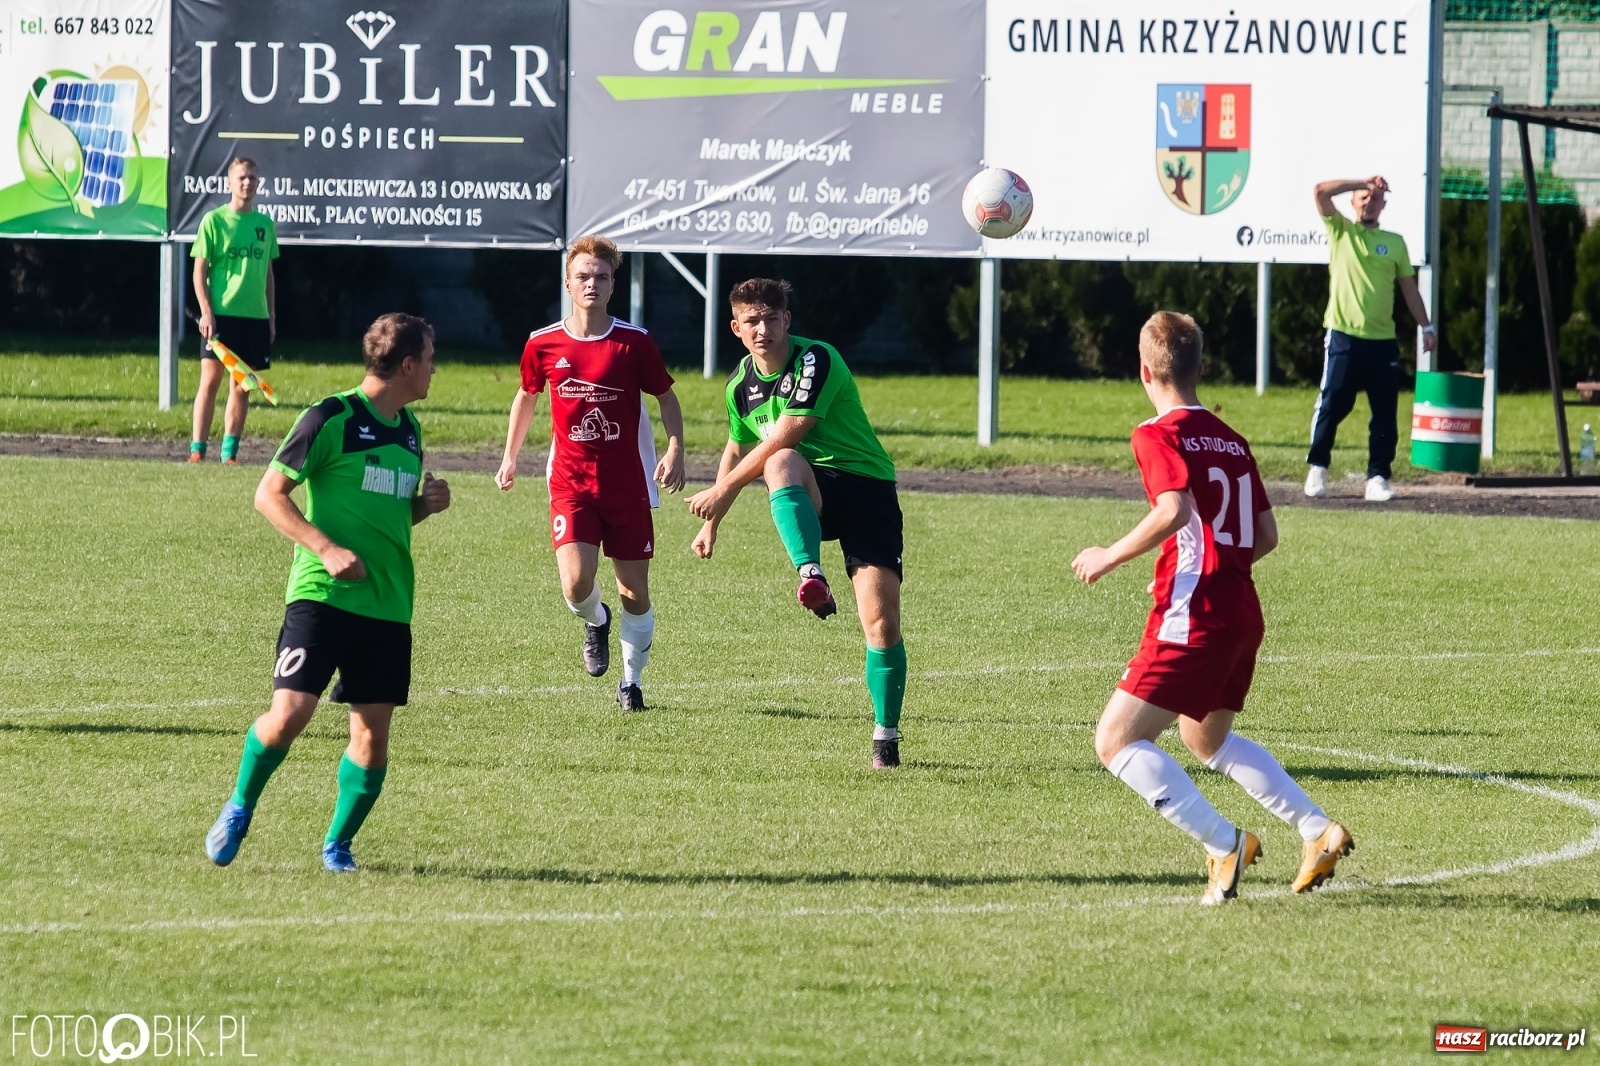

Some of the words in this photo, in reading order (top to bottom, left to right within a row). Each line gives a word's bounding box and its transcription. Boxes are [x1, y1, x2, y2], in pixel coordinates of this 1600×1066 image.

[20, 16, 48, 34] tel.
[54, 17, 84, 34] 667
[90, 18, 119, 35] 843
[125, 18, 153, 35] 022
[1008, 18, 1125, 54] GMINA
[1140, 10, 1407, 55] KRZYŻANOWICE
[633, 9, 847, 73] GRAN
[850, 93, 943, 114] MEBLE
[304, 123, 435, 150] POŚPIECH
[700, 138, 761, 160] Marek
[765, 138, 852, 163] Mańczyk
[274, 177, 299, 196] UL.
[303, 179, 416, 199] MICKIEWICZA
[421, 180, 437, 198] 13
[450, 181, 532, 200] OPAWSKA
[536, 182, 552, 200] 18
[624, 179, 687, 200] 47-451
[788, 181, 809, 203] ul.
[815, 177, 848, 203] Św.
[854, 182, 901, 204] Jana
[908, 183, 931, 205] 16
[325, 207, 367, 225] PLAC
[371, 203, 462, 226] WOLNOŚCI
[466, 208, 482, 226] 15
[695, 210, 731, 232] 323
[735, 211, 774, 235] 630,
[255, 227, 265, 242] 12
[1208, 467, 1254, 548] 21
[553, 514, 567, 541] 9
[274, 646, 307, 678] 10
